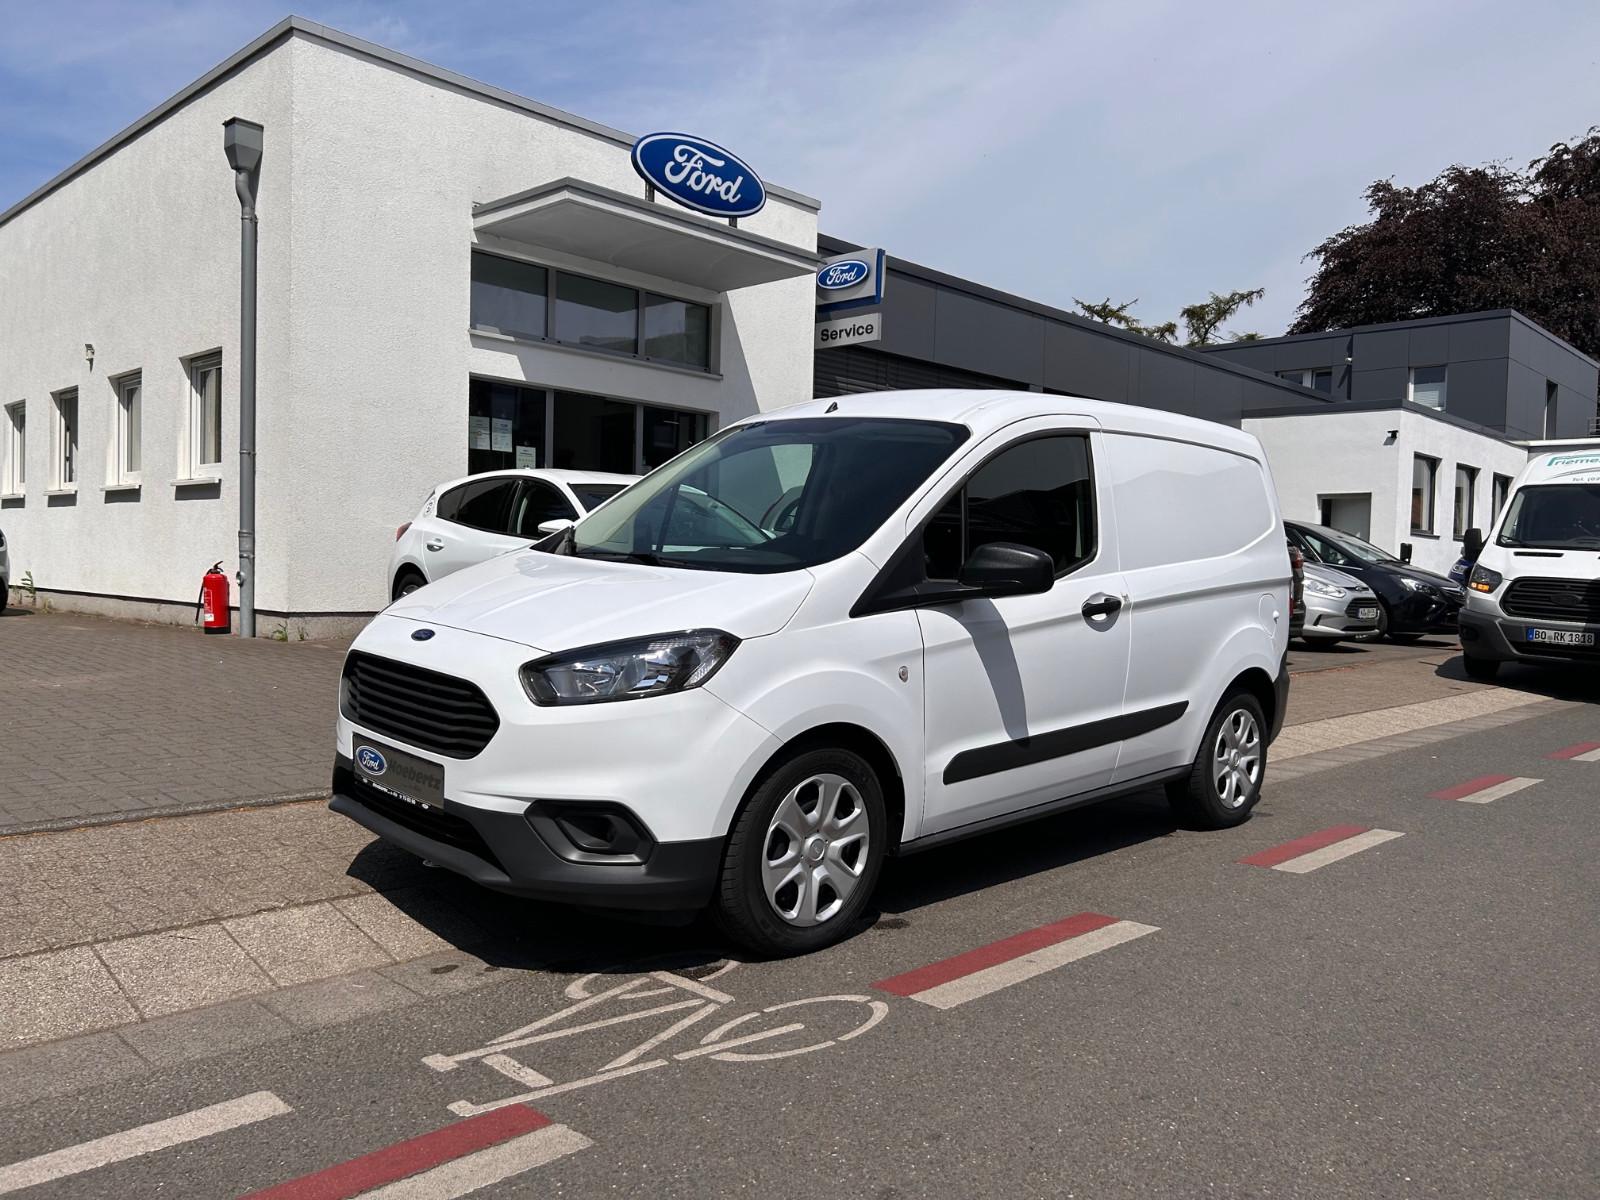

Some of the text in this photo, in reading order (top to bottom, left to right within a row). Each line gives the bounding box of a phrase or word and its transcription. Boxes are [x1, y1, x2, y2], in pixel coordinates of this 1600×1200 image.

[664, 144, 744, 203] Ford
[826, 265, 857, 285] Ford
[820, 322, 874, 342] Service
[1534, 630, 1593, 644] BO RK 1818
[362, 750, 380, 771] Ford
